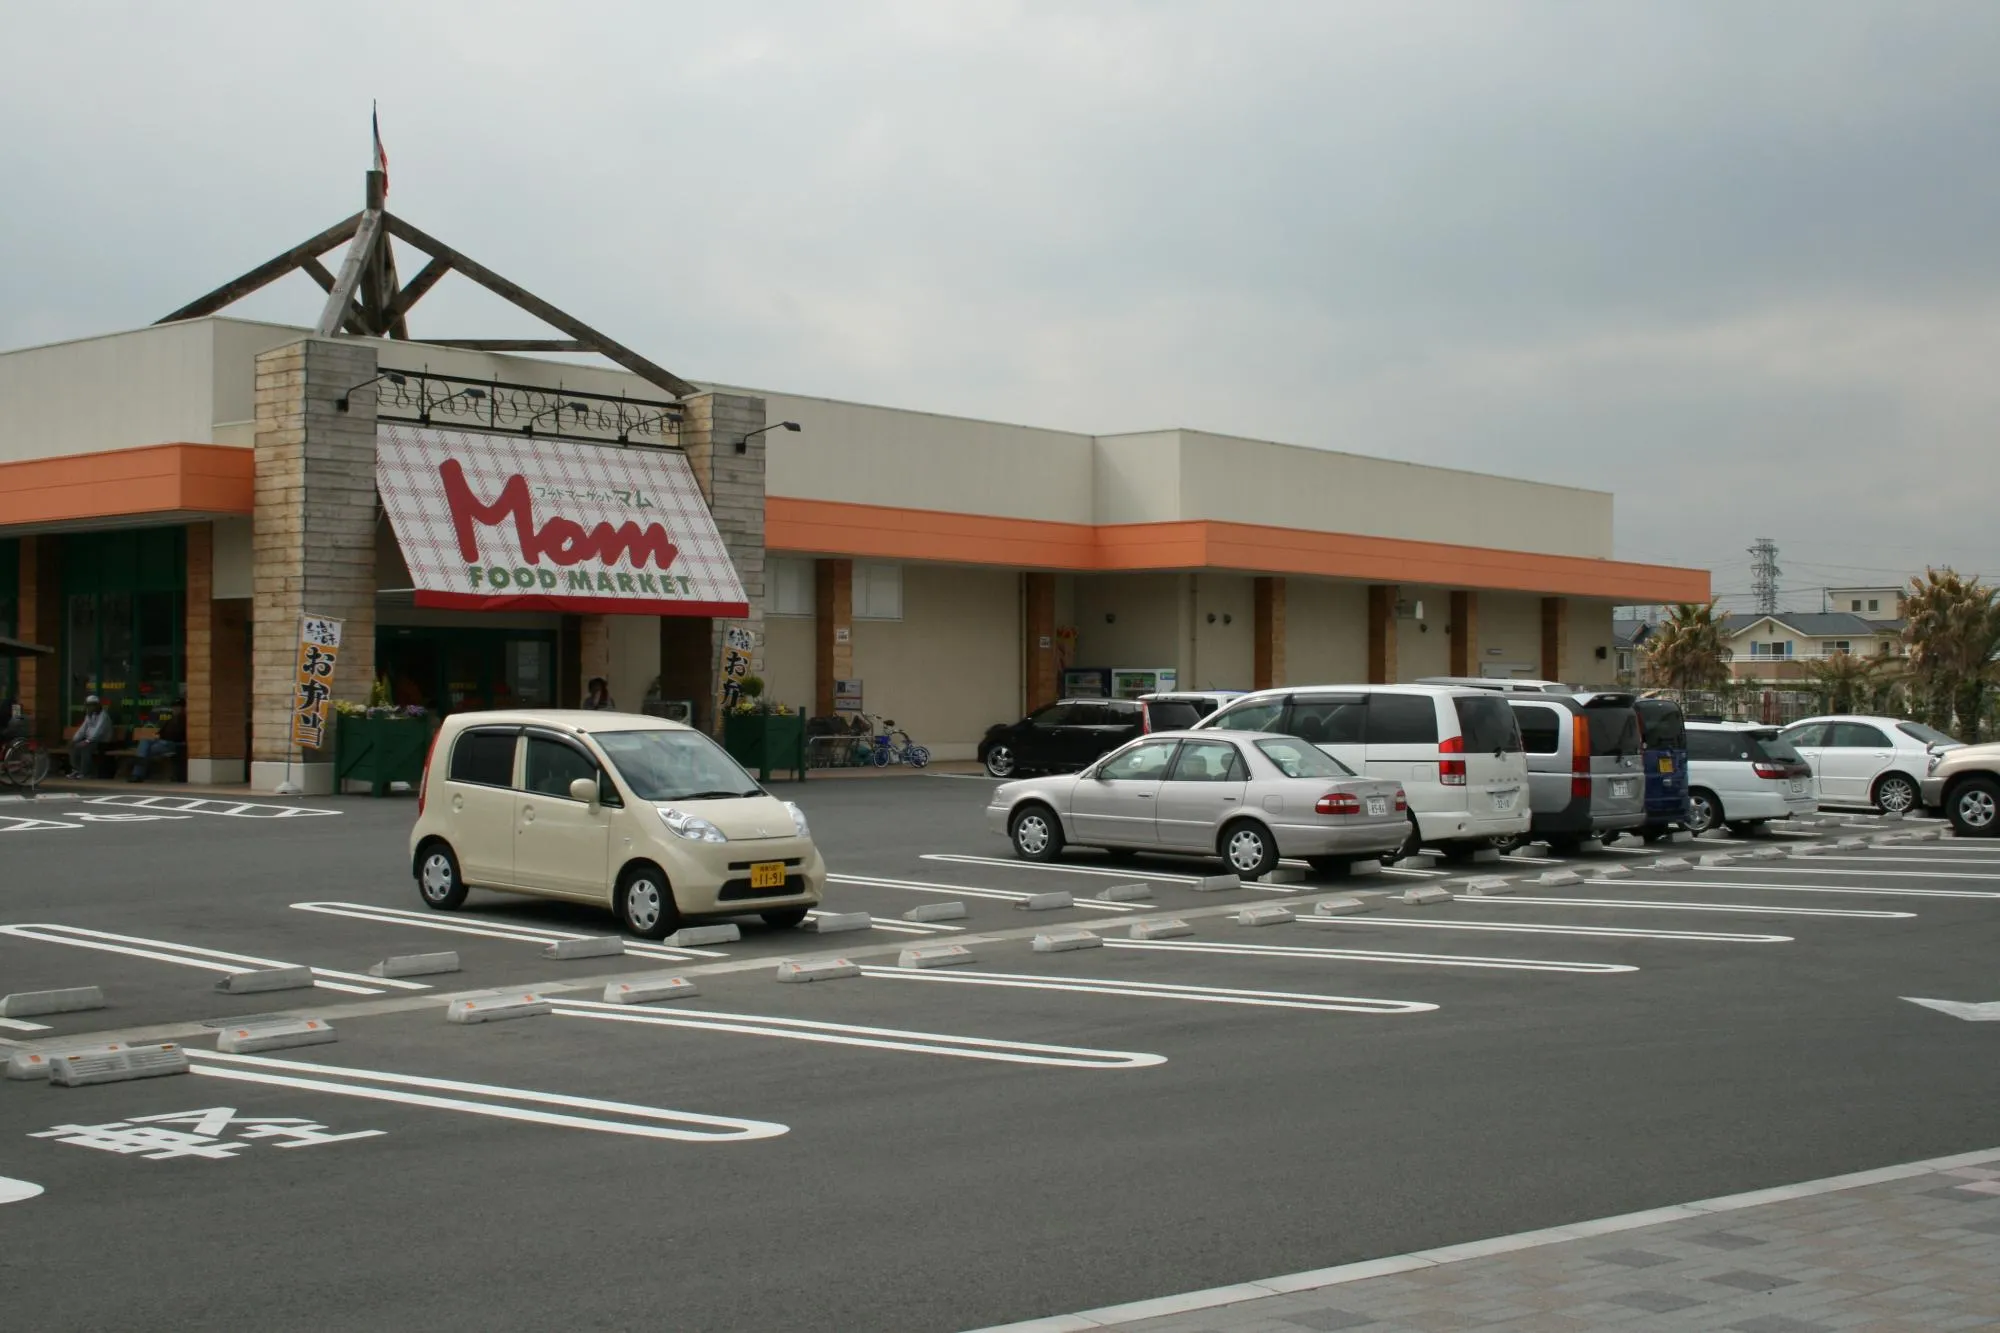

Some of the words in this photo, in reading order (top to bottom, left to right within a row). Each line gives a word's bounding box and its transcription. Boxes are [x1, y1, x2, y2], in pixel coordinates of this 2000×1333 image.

[439, 458, 679, 570] Mom
[612, 489, 654, 508] マム
[468, 566, 557, 589] FOOD
[568, 570, 692, 595] MARKET
[296, 646, 336, 746] お弁当
